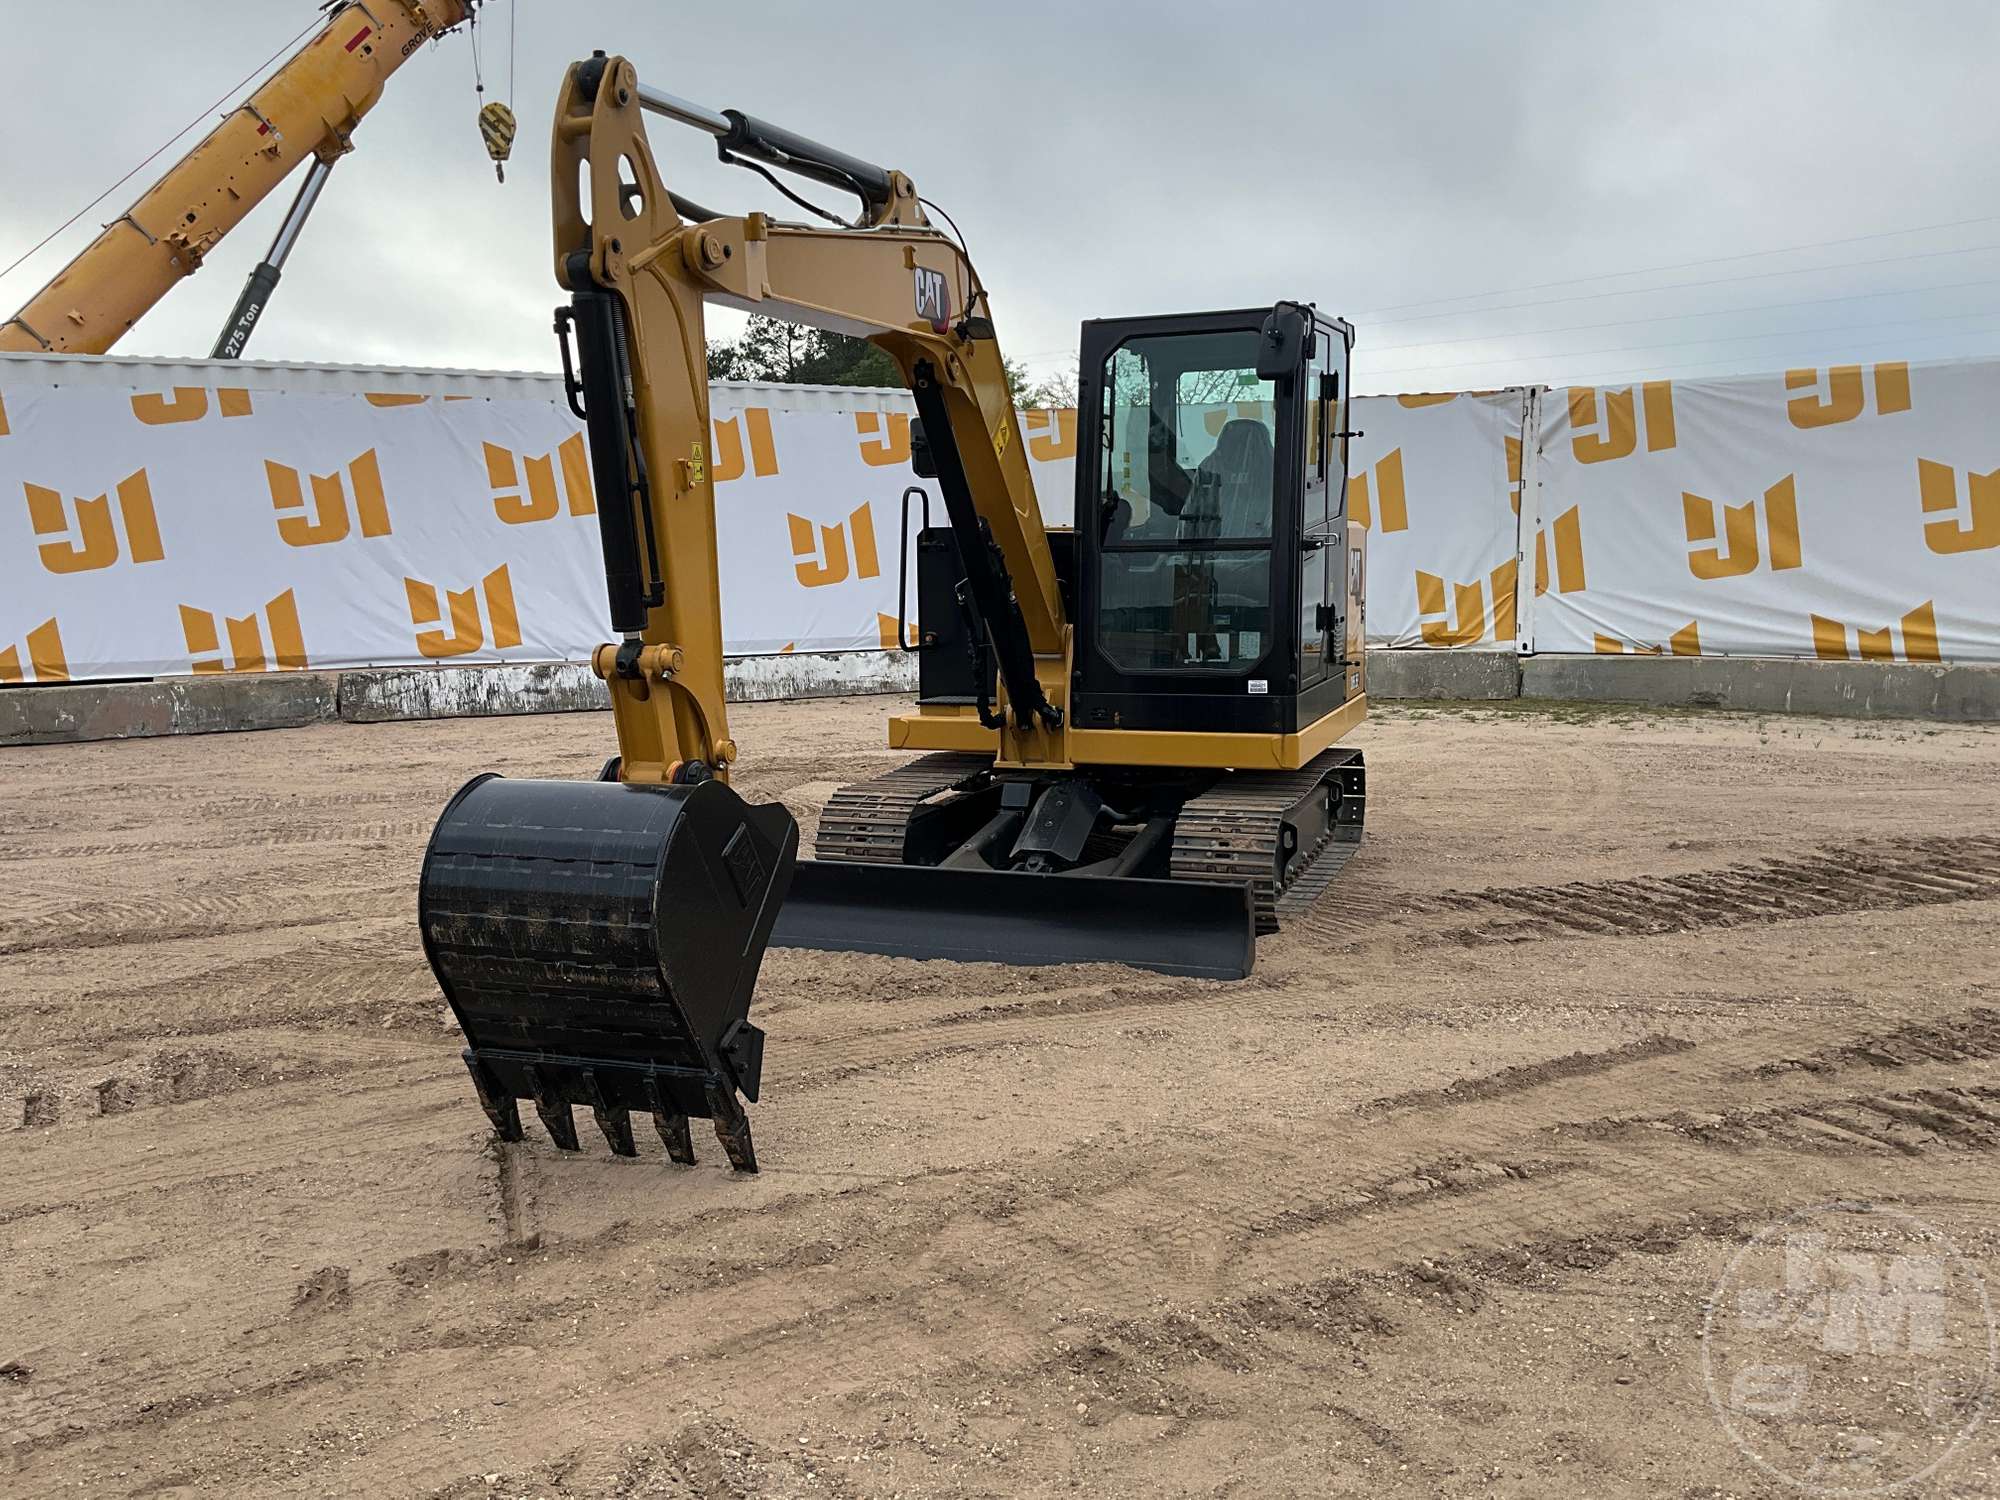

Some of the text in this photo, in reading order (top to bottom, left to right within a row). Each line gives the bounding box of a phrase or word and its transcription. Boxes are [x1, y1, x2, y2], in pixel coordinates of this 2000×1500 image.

[401, 21, 435, 56] GROVE
[914, 267, 942, 320] CAT
[225, 303, 260, 357] 275 Ton
